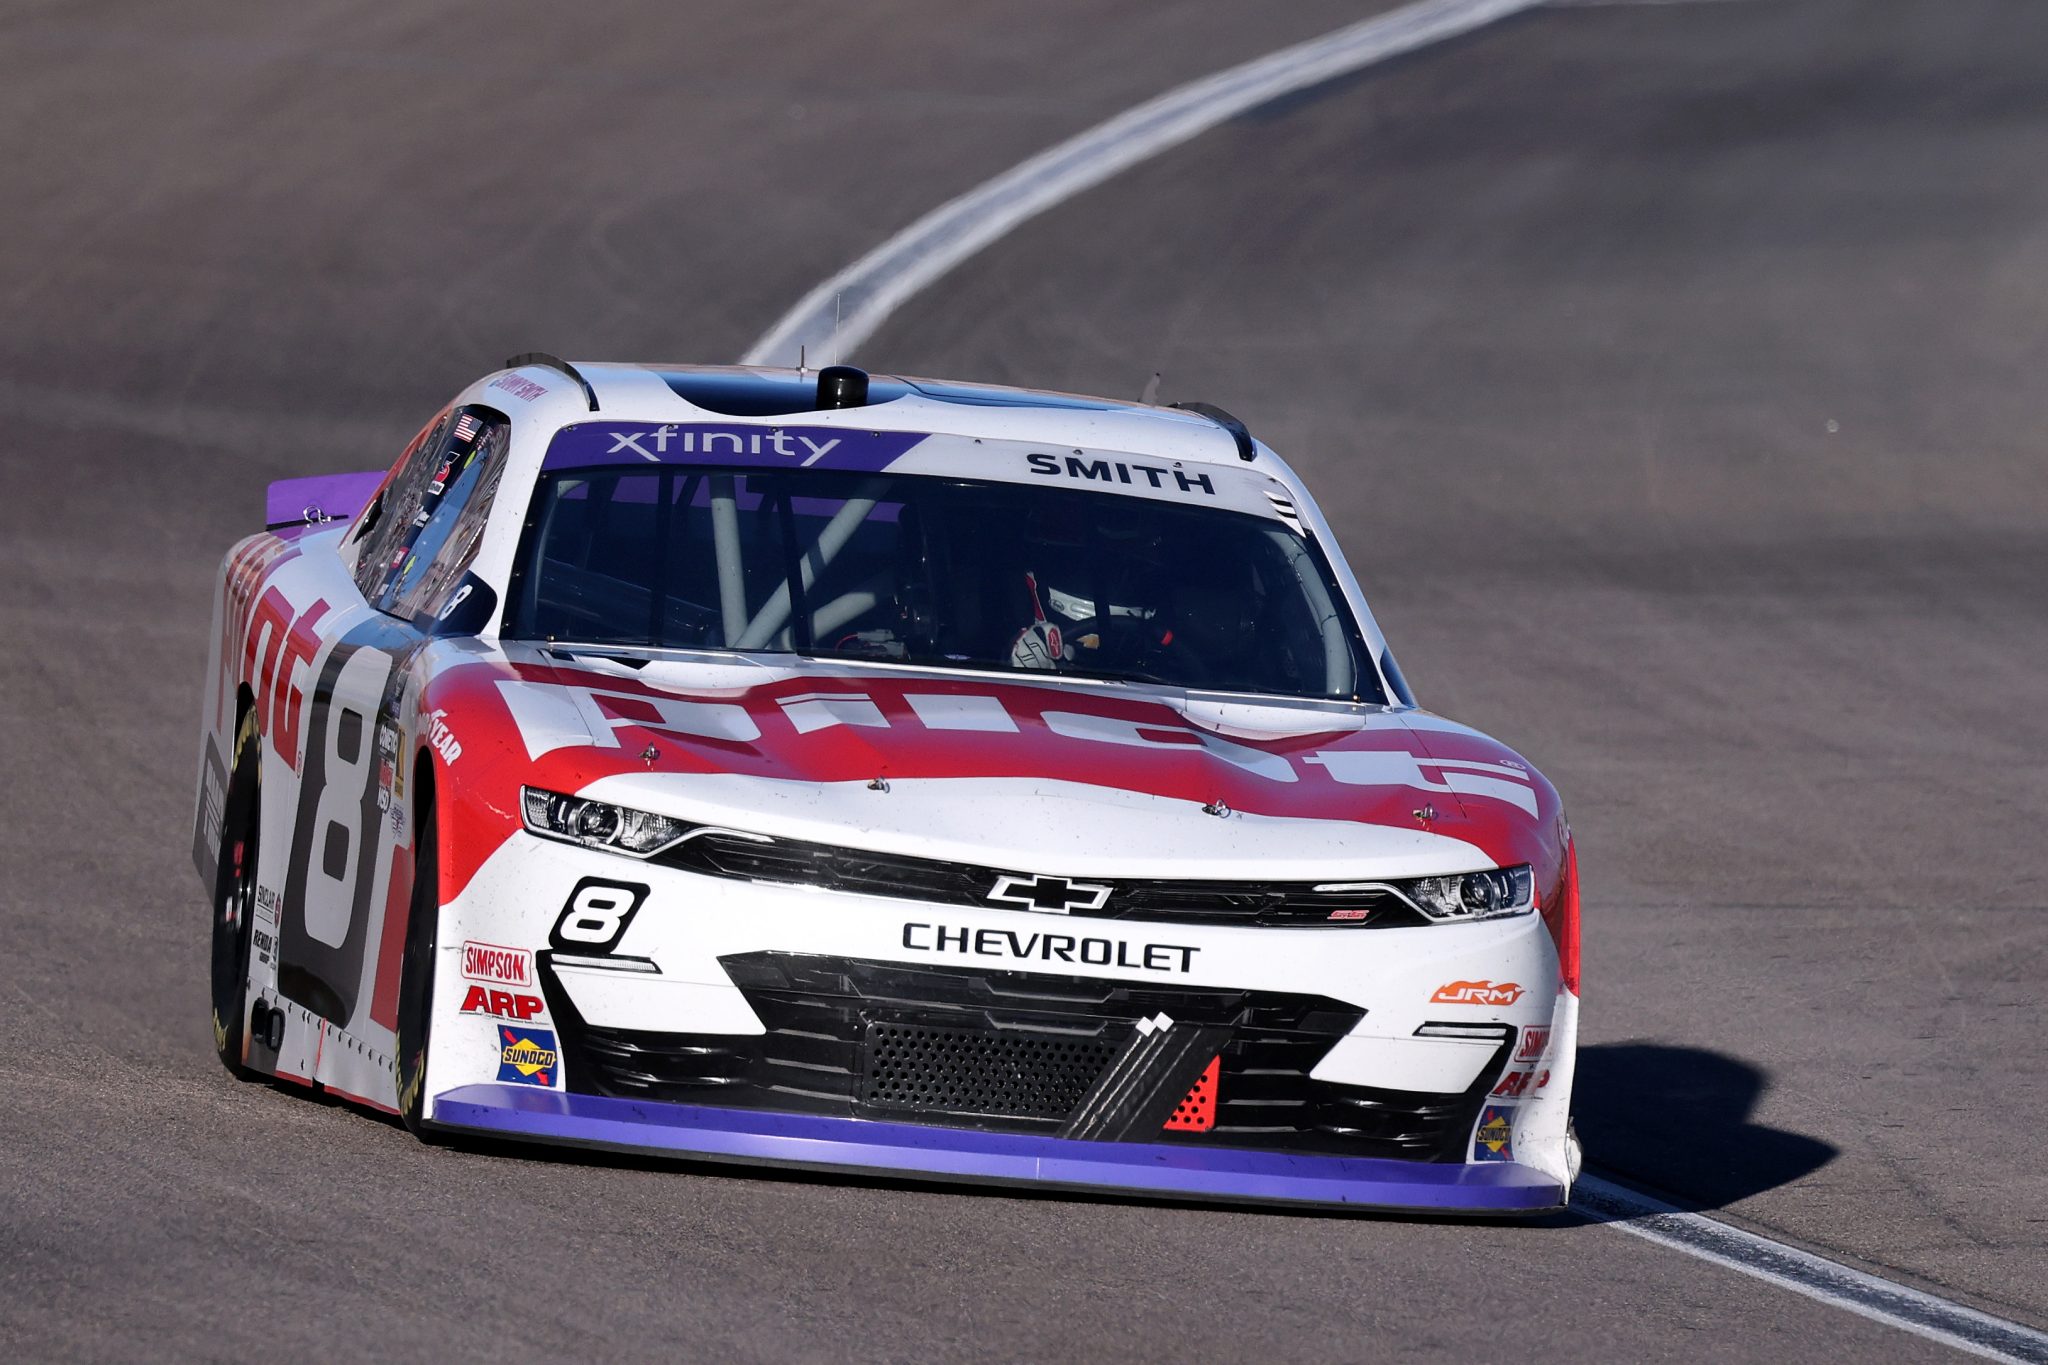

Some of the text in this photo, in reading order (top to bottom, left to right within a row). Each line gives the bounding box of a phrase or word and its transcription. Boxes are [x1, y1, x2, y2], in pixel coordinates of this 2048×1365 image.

[606, 424, 842, 467] xfinity
[1026, 452, 1214, 495] SMITH
[440, 585, 473, 621] 8
[290, 632, 398, 990] 8
[555, 881, 643, 948] 8
[466, 946, 525, 981] SIMPSON
[903, 923, 1201, 973] CHEVROLET
[460, 985, 544, 1020] ARP
[1435, 985, 1518, 1005] JRM
[505, 1048, 554, 1066] SUNOCO
